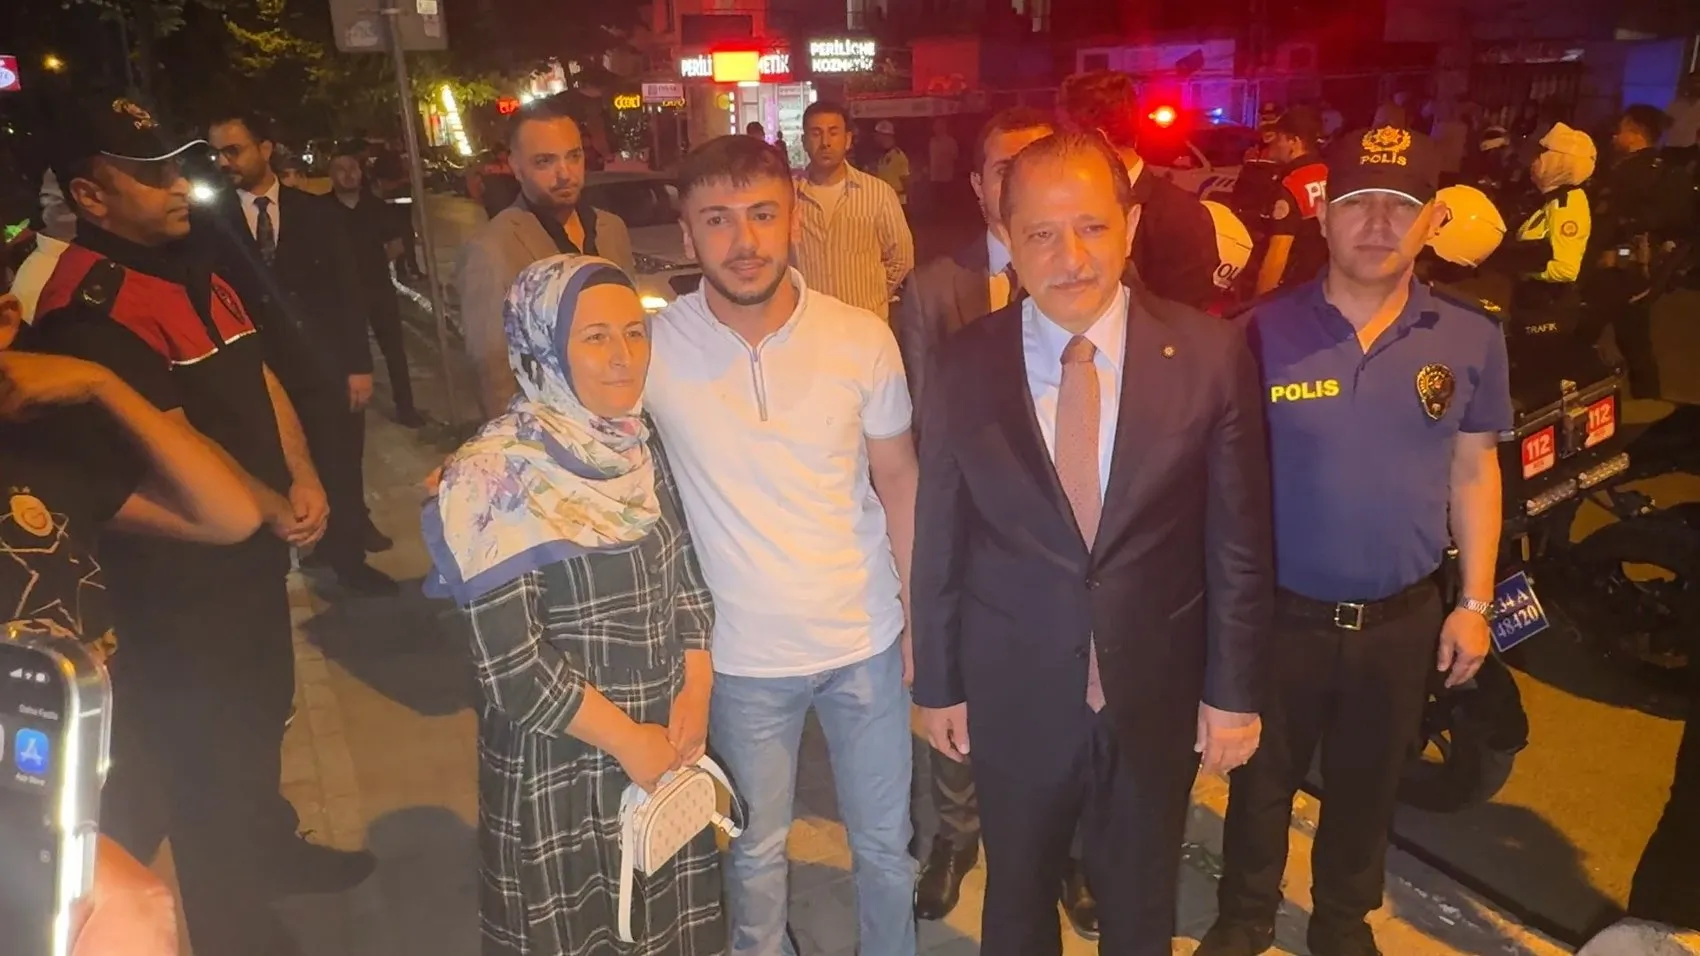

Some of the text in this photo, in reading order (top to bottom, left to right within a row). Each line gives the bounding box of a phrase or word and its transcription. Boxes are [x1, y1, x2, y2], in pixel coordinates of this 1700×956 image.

[1586, 403, 1612, 431] 112
[1526, 434, 1551, 462] 112
[1516, 587, 1530, 604] A
